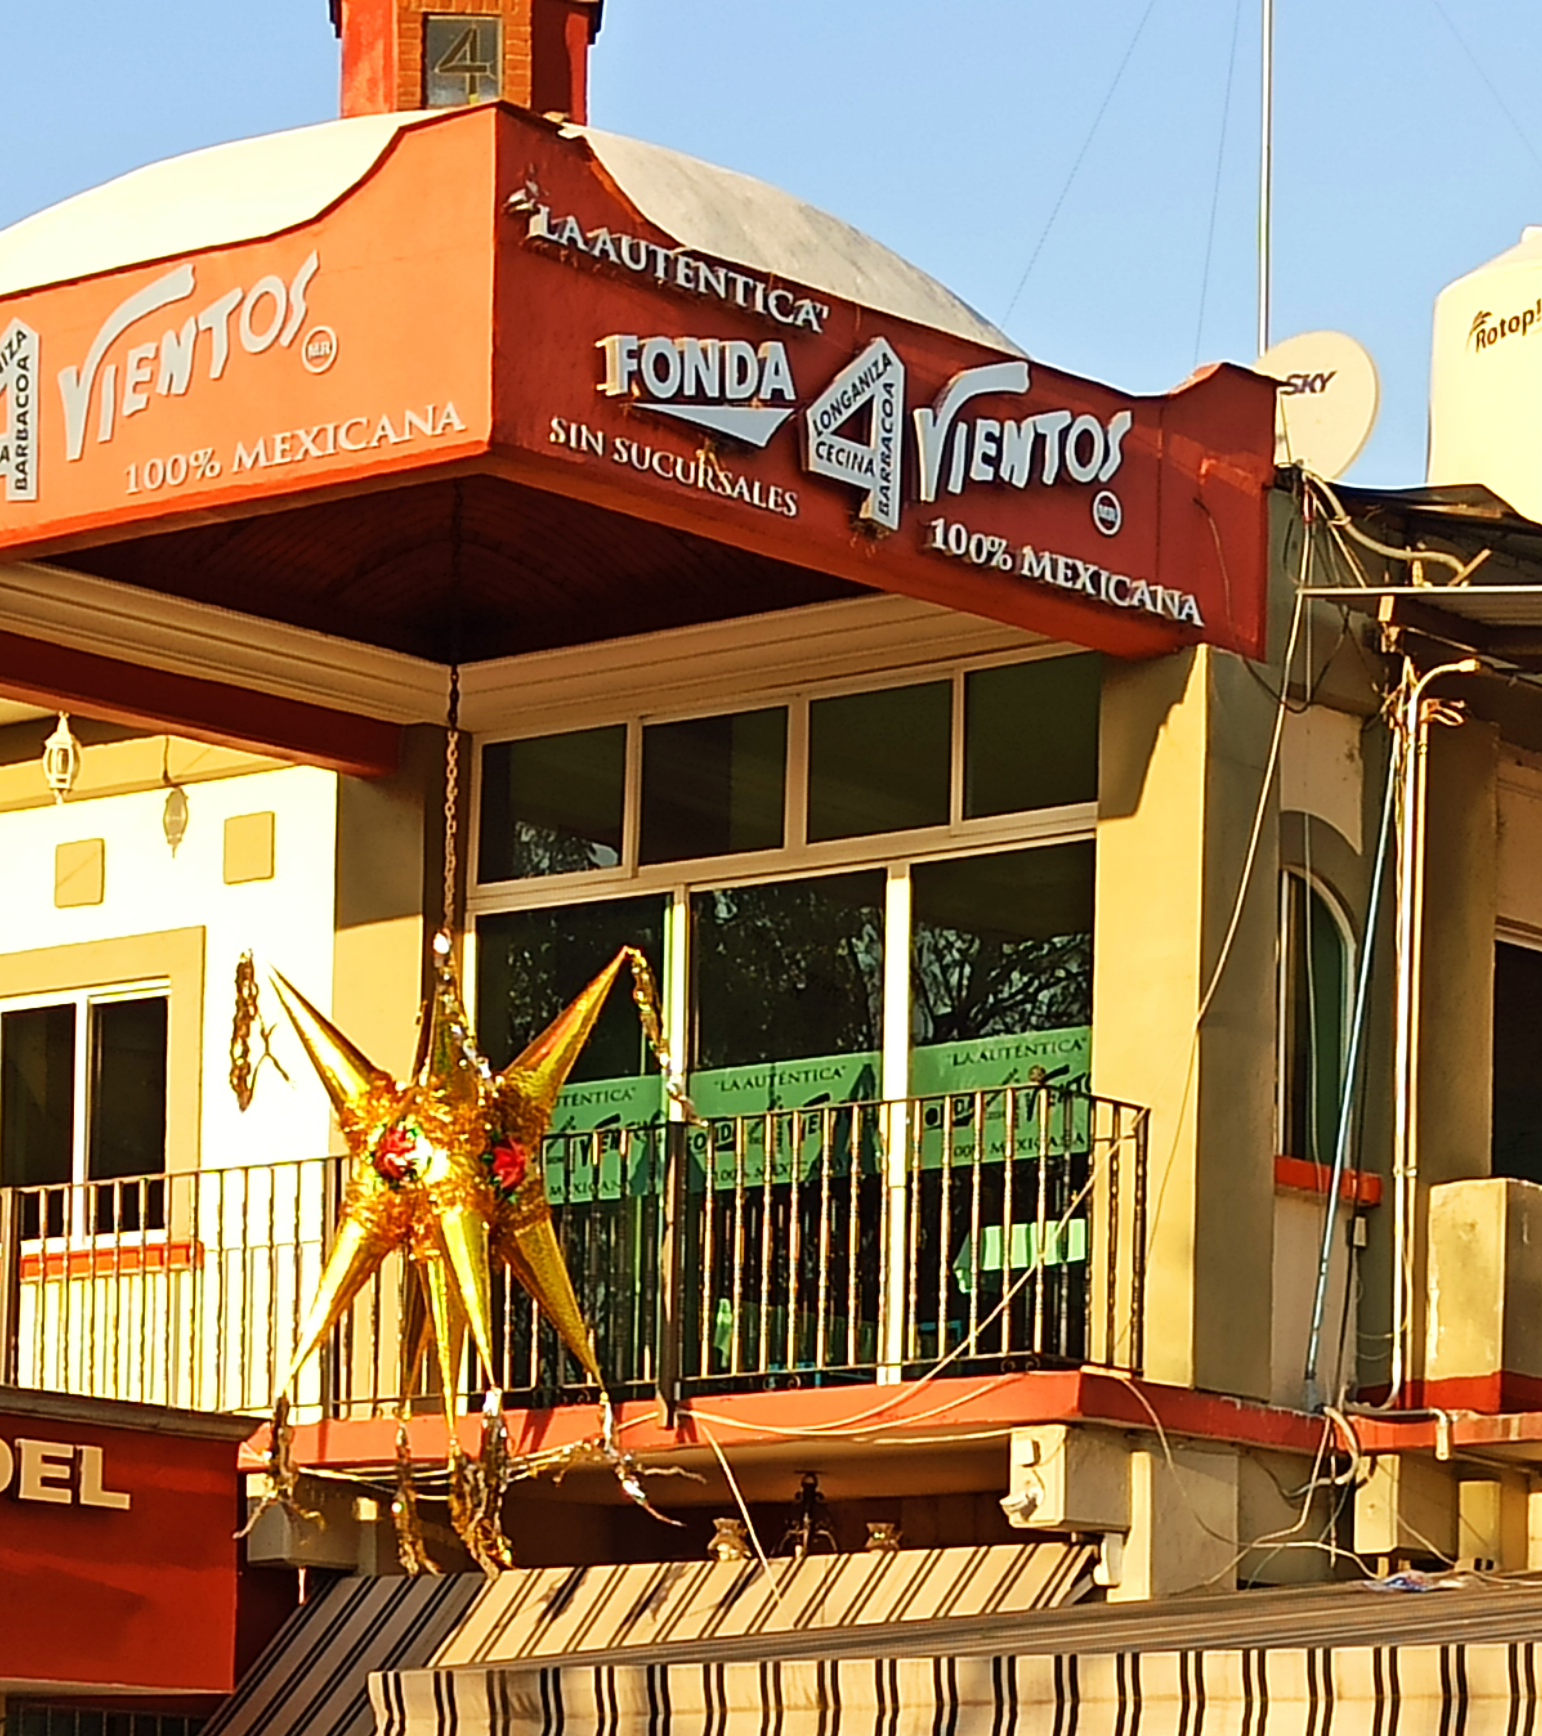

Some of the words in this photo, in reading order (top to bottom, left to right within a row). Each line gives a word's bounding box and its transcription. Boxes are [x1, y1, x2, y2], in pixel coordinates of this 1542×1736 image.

[57, 249, 321, 462] VIENTOS
[812, 351, 894, 438] LONGANIZA
[1281, 369, 1337, 397] SKY
[13, 354, 31, 491] BARBACOA
[123, 447, 221, 495] 100%
[230, 401, 468, 474] MEXICANA
[549, 417, 605, 457] SIN
[612, 436, 799, 518] SUCURSALES
[595, 333, 797, 401] FONDA
[802, 336, 906, 532] 4
[912, 360, 1133, 503] VIENTOS
[814, 440, 877, 477] CECINA
[878, 380, 896, 518] BARBACOA
[930, 516, 1014, 571] 100%
[1020, 545, 1206, 628] MEXICANA
